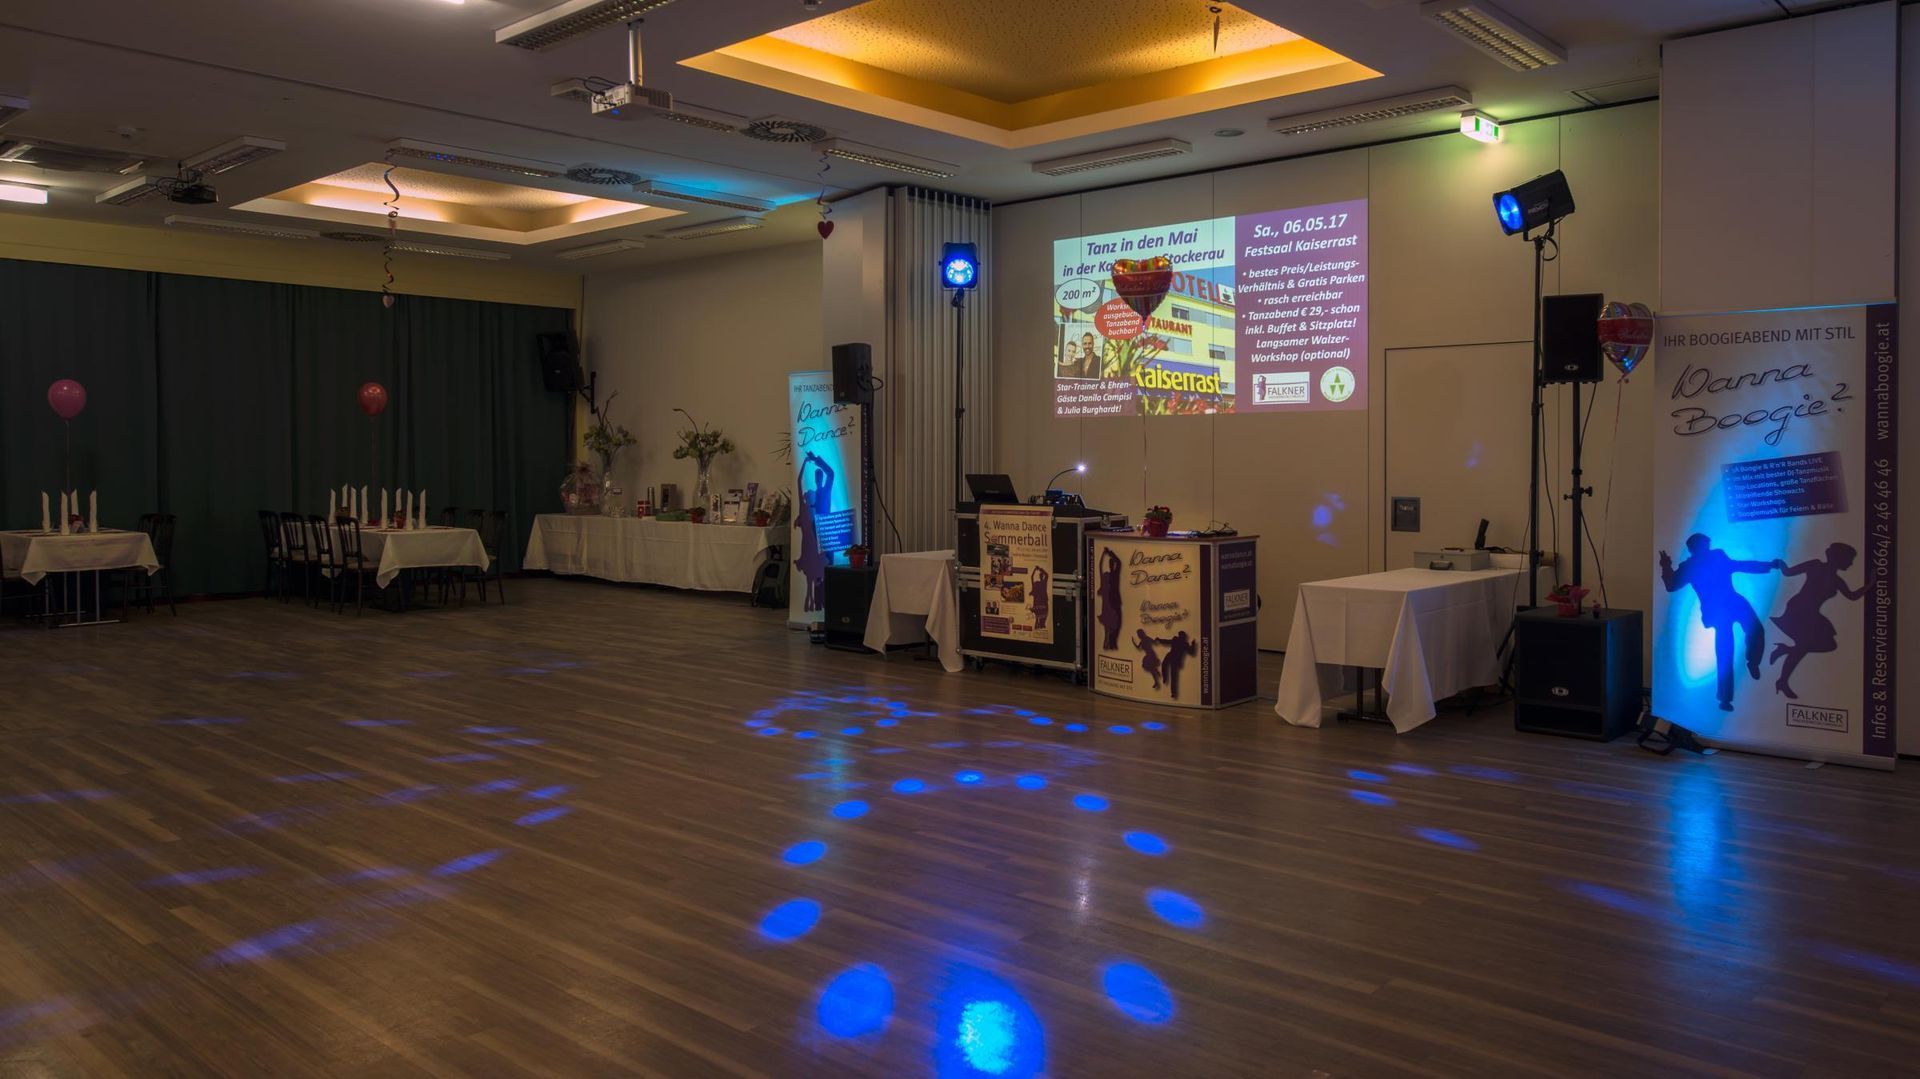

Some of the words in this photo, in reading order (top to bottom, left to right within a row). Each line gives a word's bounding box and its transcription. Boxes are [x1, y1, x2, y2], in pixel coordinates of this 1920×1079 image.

[1254, 224, 1279, 238] Sa.,
[1283, 213, 1348, 234] 06.05.17
[1087, 241, 1116, 256] Tanz
[1120, 238, 1133, 252] in
[1137, 234, 1164, 250] den
[1168, 228, 1198, 246] Mai
[1245, 241, 1293, 258] Festsaal
[1295, 234, 1358, 252] Kaiserrast
[1063, 265, 1073, 277] in
[1077, 262, 1096, 275] der
[1248, 267, 1279, 278] bestes
[1280, 259, 1360, 275] Preis/Leistungs-
[1171, 271, 1221, 304] OTEL
[1238, 279, 1285, 293] Verhältnis
[1286, 279, 1295, 289] &
[1297, 276, 1328, 288] Gratis
[1329, 273, 1365, 285] Parken
[1062, 289, 1080, 301] 200
[1264, 294, 1289, 305] rasch
[1291, 290, 1344, 302] erreichbar
[1248, 307, 1299, 320] Tanzabend
[1301, 307, 1308, 317] €
[1331, 303, 1360, 314] schon
[1106, 318, 1140, 328] Tanzabend
[1245, 324, 1265, 335] inkl.
[1267, 322, 1297, 335] Buffet
[1299, 322, 1307, 331] &
[1309, 318, 1357, 331] Sitzplatz!
[1256, 337, 1309, 349] Langsamer
[1311, 334, 1350, 345] Walzer-
[1664, 335, 1685, 347] IHR
[1690, 330, 1791, 346] BOOGIEABEND
[1795, 328, 1822, 341] MIT
[1825, 326, 1855, 340] STIL
[1251, 351, 1298, 363] Workshop
[1300, 348, 1351, 361] (optional)
[1057, 382, 1099, 391] Star-Trainer
[1099, 381, 1106, 389] &
[1874, 321, 1893, 440] wannaboogie.at
[1078, 393, 1102, 402] Danilo
[1103, 392, 1133, 402] Campisi
[1267, 385, 1305, 396] FALKNER
[1057, 406, 1063, 414] &
[1064, 406, 1081, 414] Julia
[1082, 405, 1121, 415] Burghardt!
[1874, 458, 1892, 477] 46
[1874, 480, 1892, 499] 46
[1874, 502, 1892, 521] 46
[993, 520, 1020, 531] Wanna
[1022, 521, 1047, 532] Dance
[1871, 580, 1892, 687] Reservierungen
[1100, 660, 1130, 674] FALKNER
[1873, 691, 1887, 701] &
[1791, 708, 1844, 724] FALKNER
[1871, 704, 1888, 739] Infos
